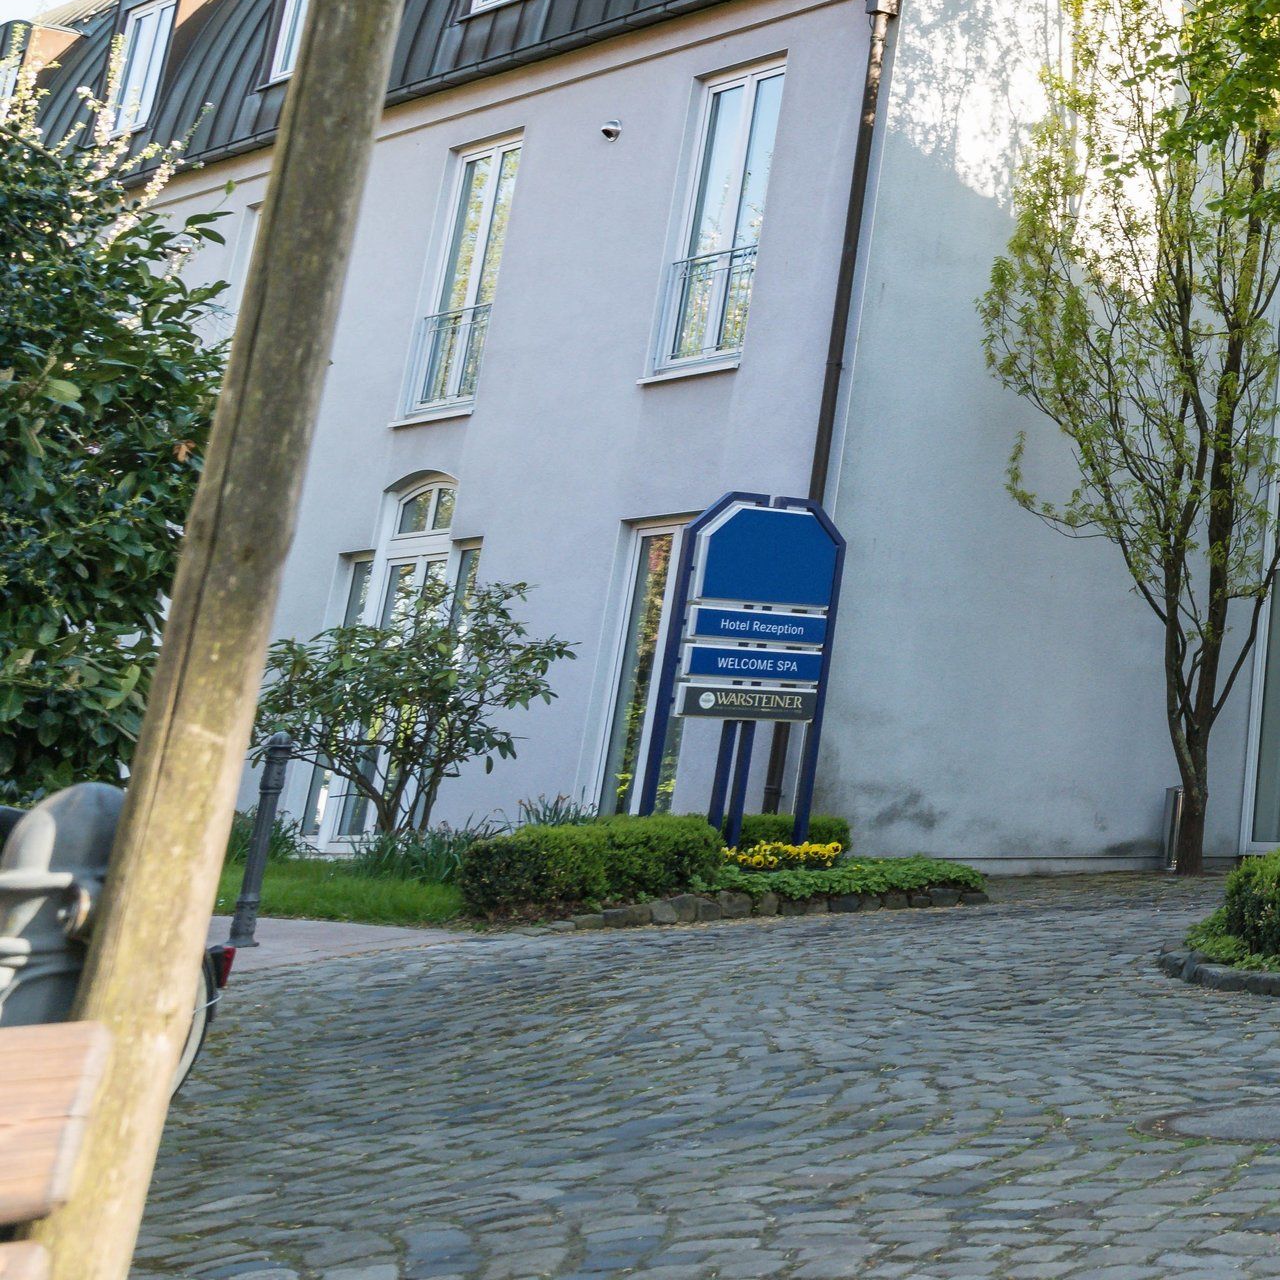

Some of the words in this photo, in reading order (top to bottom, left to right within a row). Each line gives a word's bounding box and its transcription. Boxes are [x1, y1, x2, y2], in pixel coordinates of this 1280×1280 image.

[720, 619, 750, 631] Hotel
[752, 621, 805, 636] Rezeption
[717, 657, 774, 671] WELCOME
[776, 660, 798, 672] SPA
[716, 692, 803, 709] WARSTEINER
